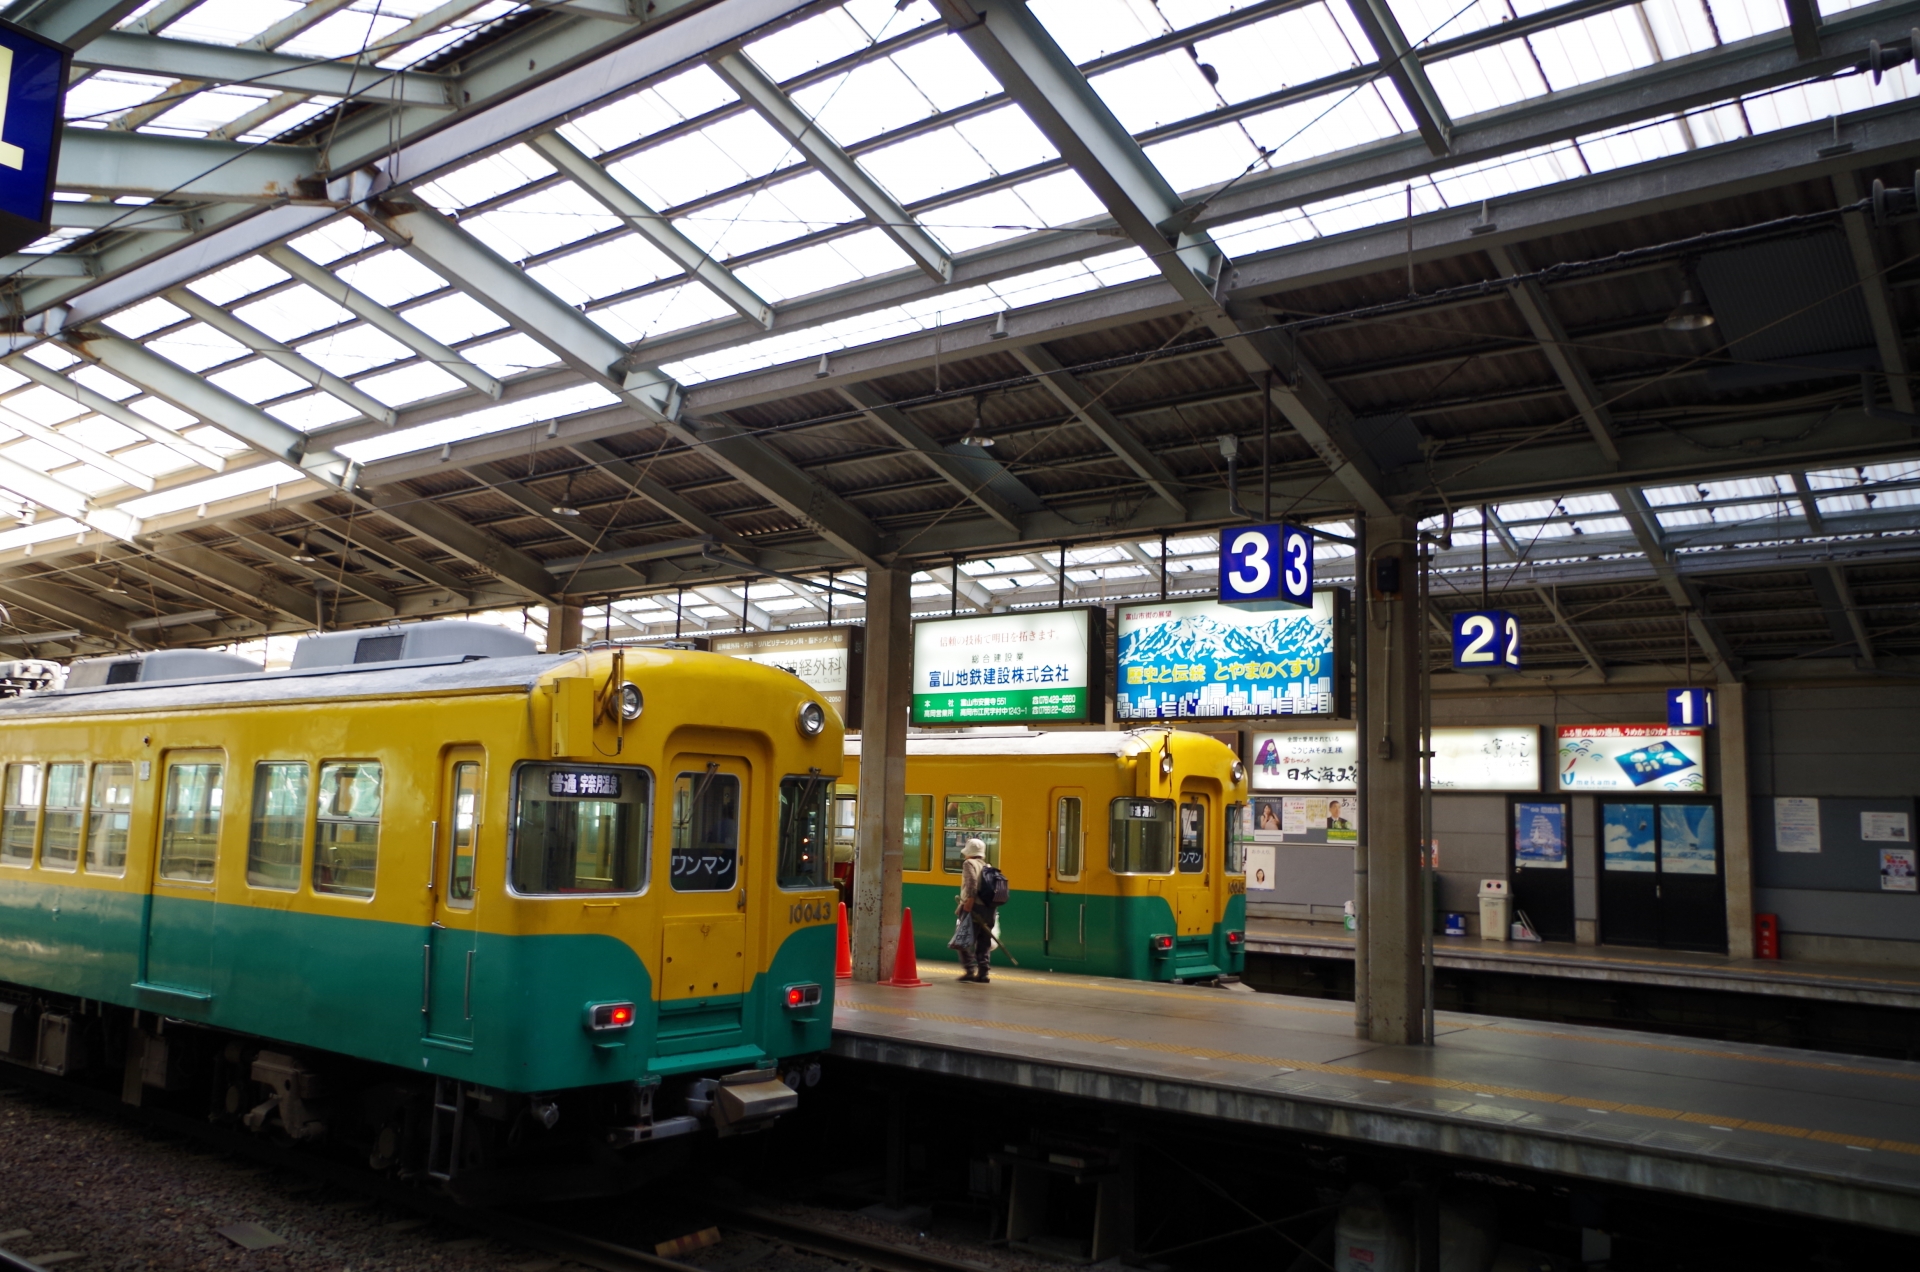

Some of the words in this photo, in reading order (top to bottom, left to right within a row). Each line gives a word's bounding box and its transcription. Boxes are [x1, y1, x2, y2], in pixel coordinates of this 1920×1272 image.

[1228, 531, 1271, 594] 3
[1285, 533, 1307, 596] 3
[1125, 610, 1172, 621] 富山市街の展望
[940, 629, 1059, 647] 信頼の技術で明日を拓きます。
[1460, 615, 1495, 662] 2
[1505, 617, 1518, 665] 2
[971, 652, 1024, 664] 総合建設業
[929, 663, 1070, 688] 富山地鉄建設株式会社
[1127, 663, 1206, 685] 歴史と伝統
[1214, 657, 1320, 681] とやまのくすり
[1675, 690, 1693, 724] 1
[1706, 691, 1713, 725] 1
[1291, 746, 1343, 754] こうじみその王様
[551, 773, 578, 794] 普通
[580, 774, 618, 795] 宇奈月温泉
[671, 856, 732, 876] ワンマン
[789, 902, 832, 923] 10043
